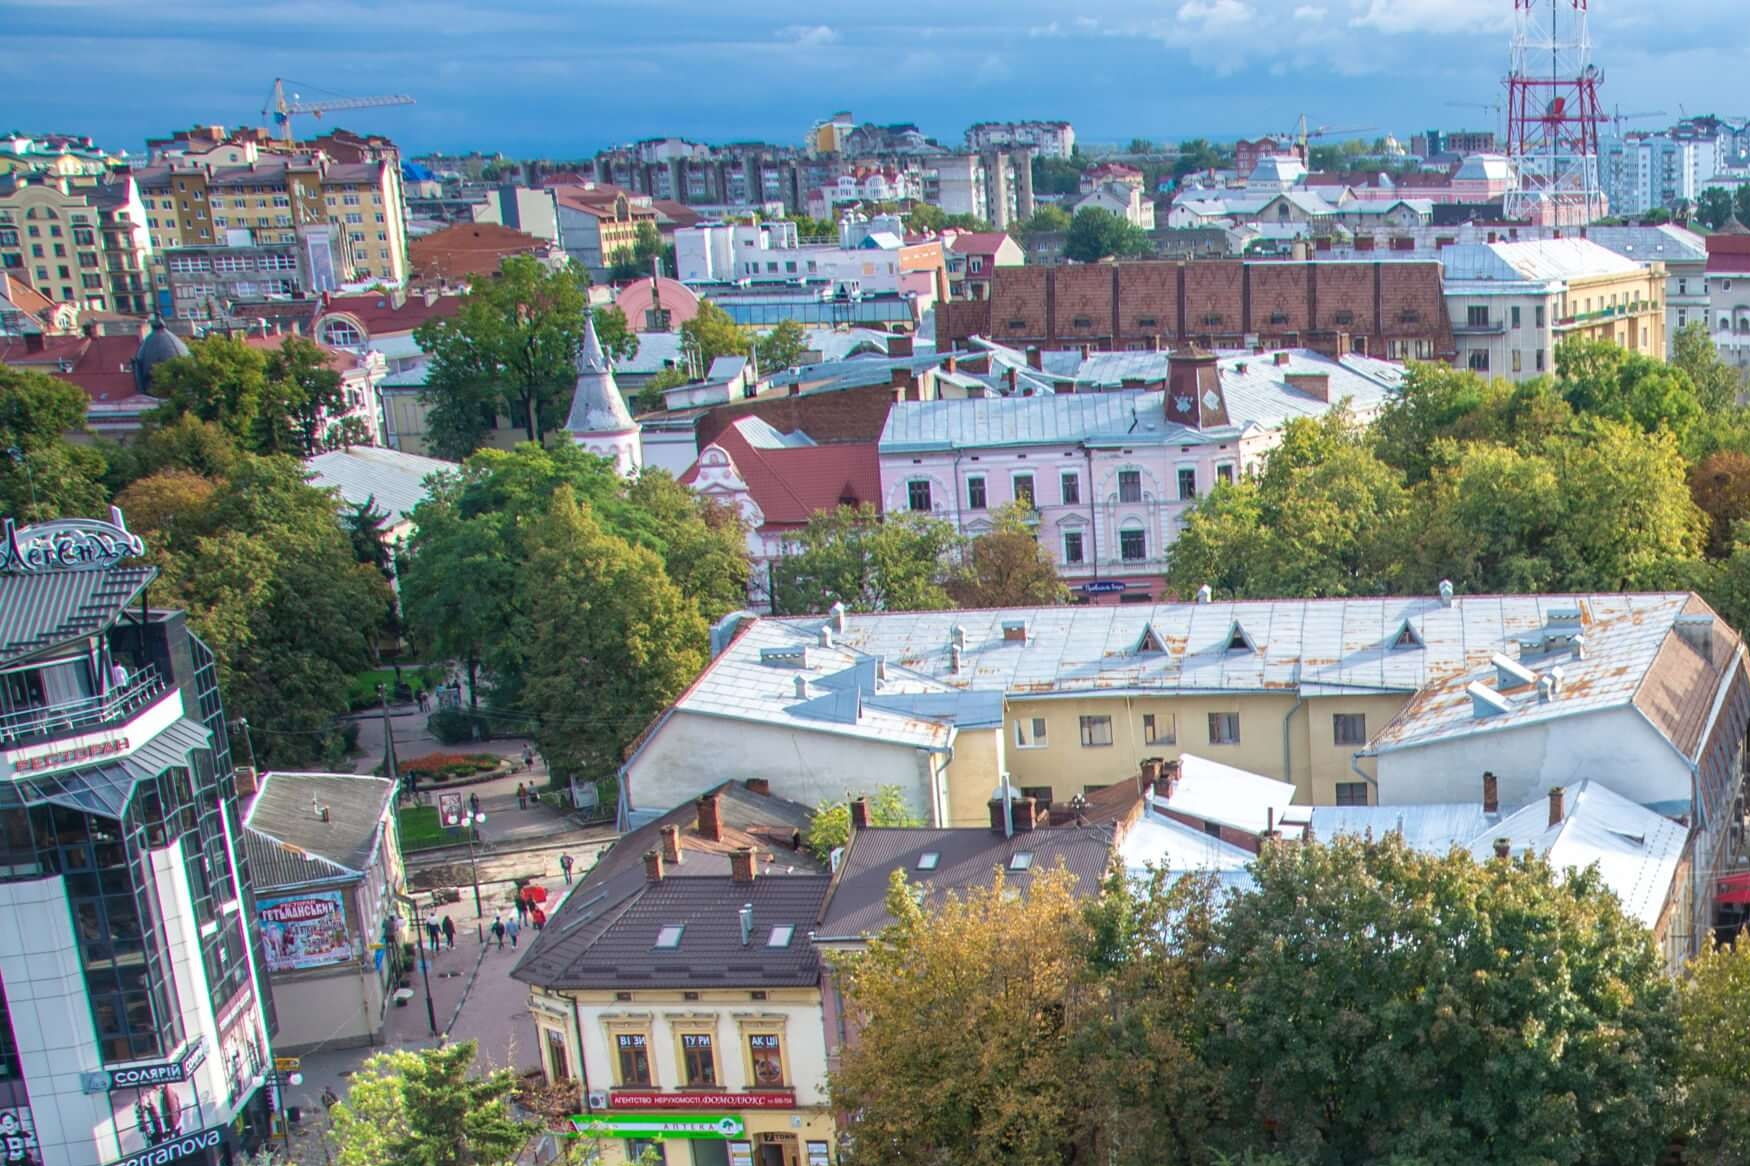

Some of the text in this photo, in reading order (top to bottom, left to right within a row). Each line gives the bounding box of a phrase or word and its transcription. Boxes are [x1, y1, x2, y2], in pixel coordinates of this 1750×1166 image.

[16, 737, 130, 772] РЕСТОРАН
[114, 1064, 181, 1083] СОЛЯРІЙ
[614, 1096, 652, 1105] АГЕНТСТВО
[654, 1096, 700, 1105] НЕРУХОМОСТІ
[664, 1122, 715, 1130] АПТЕКА
